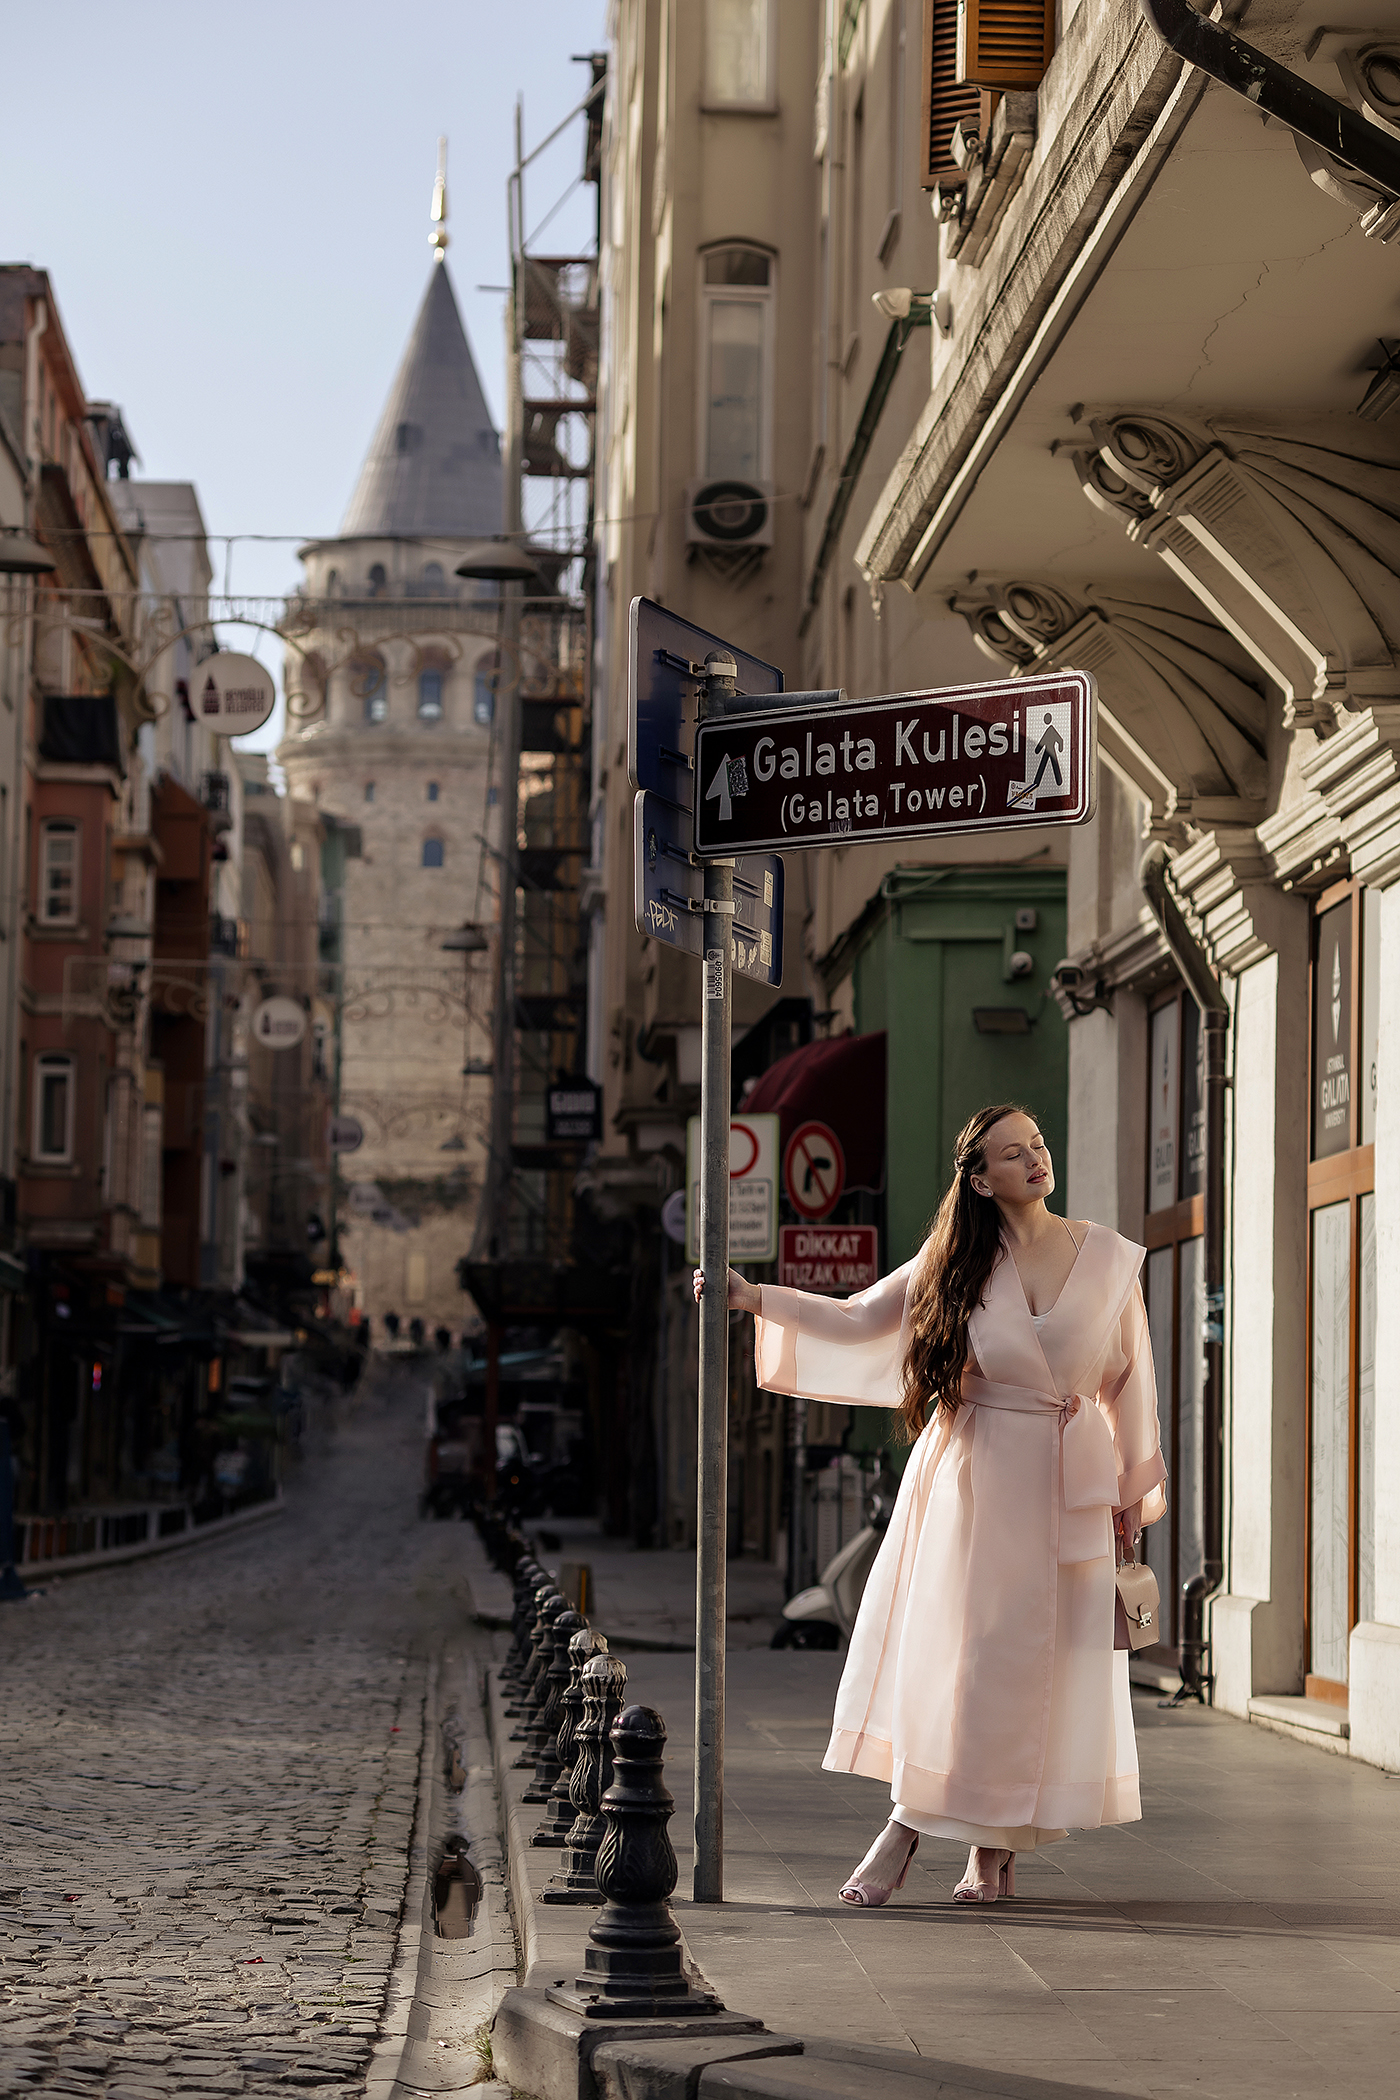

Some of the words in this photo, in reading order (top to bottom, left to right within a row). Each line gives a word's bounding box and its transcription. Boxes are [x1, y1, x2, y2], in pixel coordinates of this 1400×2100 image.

[753, 731, 876, 781] Galata
[895, 710, 1021, 766] Kulesi
[780, 790, 879, 832] (Galata
[889, 774, 988, 814] Tower)
[714, 961, 723, 997] 0905604
[1321, 1072, 1350, 1110] GALATA
